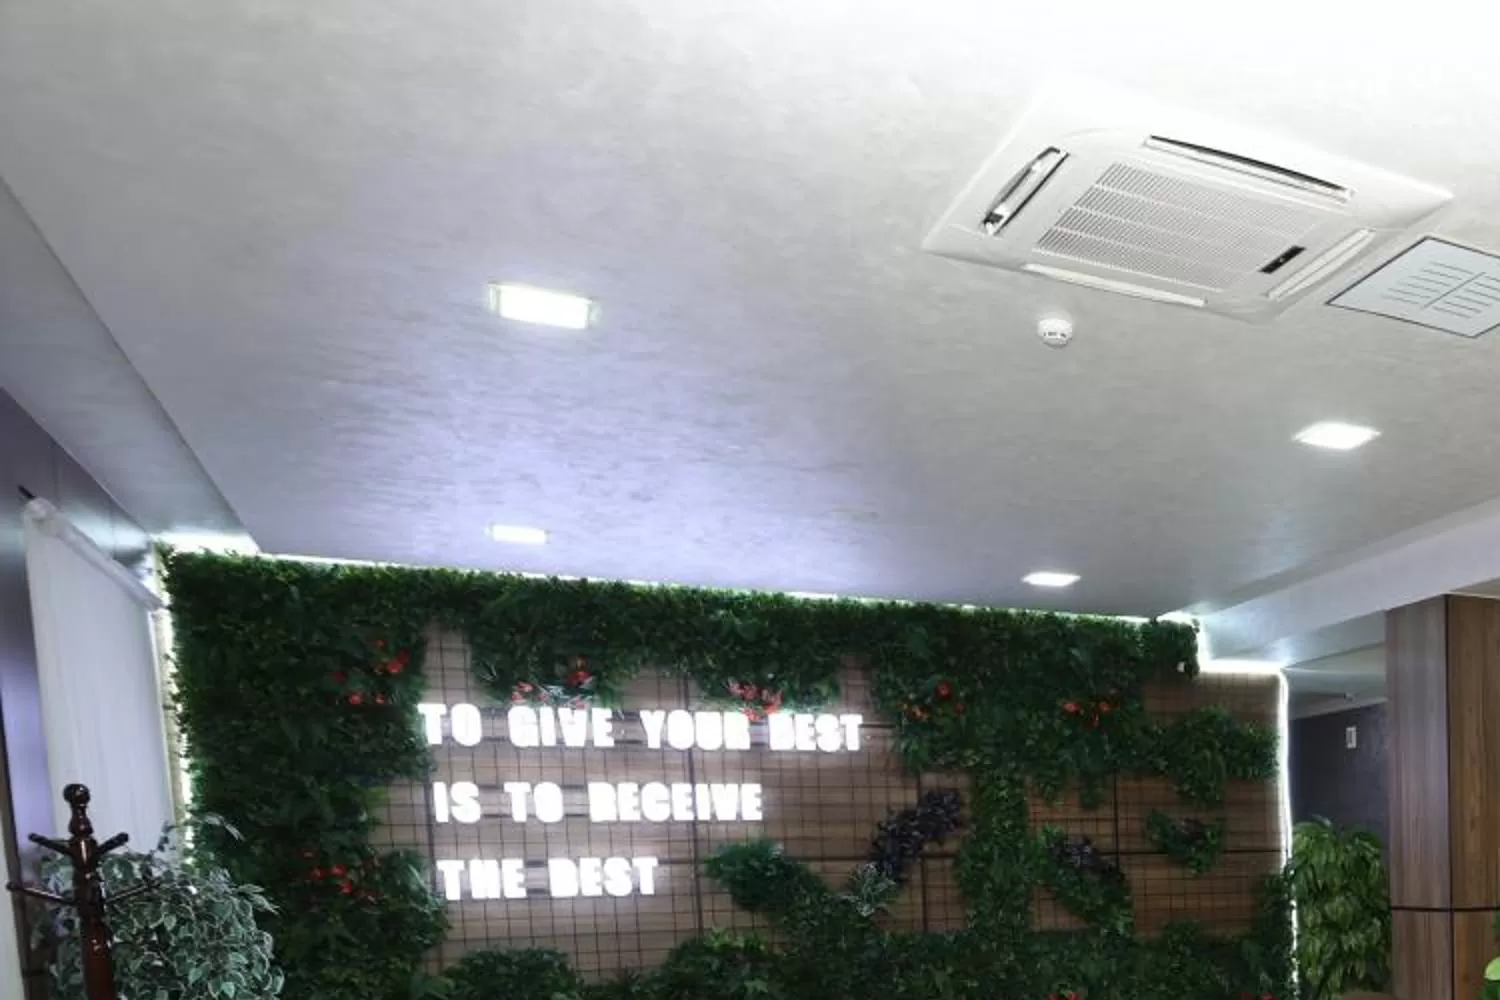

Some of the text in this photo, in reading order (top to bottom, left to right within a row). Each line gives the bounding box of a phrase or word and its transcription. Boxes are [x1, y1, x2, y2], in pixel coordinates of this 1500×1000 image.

[418, 703, 862, 752] TO GIVE YOUR BEST
[434, 782, 762, 822] IS TO RECEIVE
[437, 857, 657, 900] THE BEST
